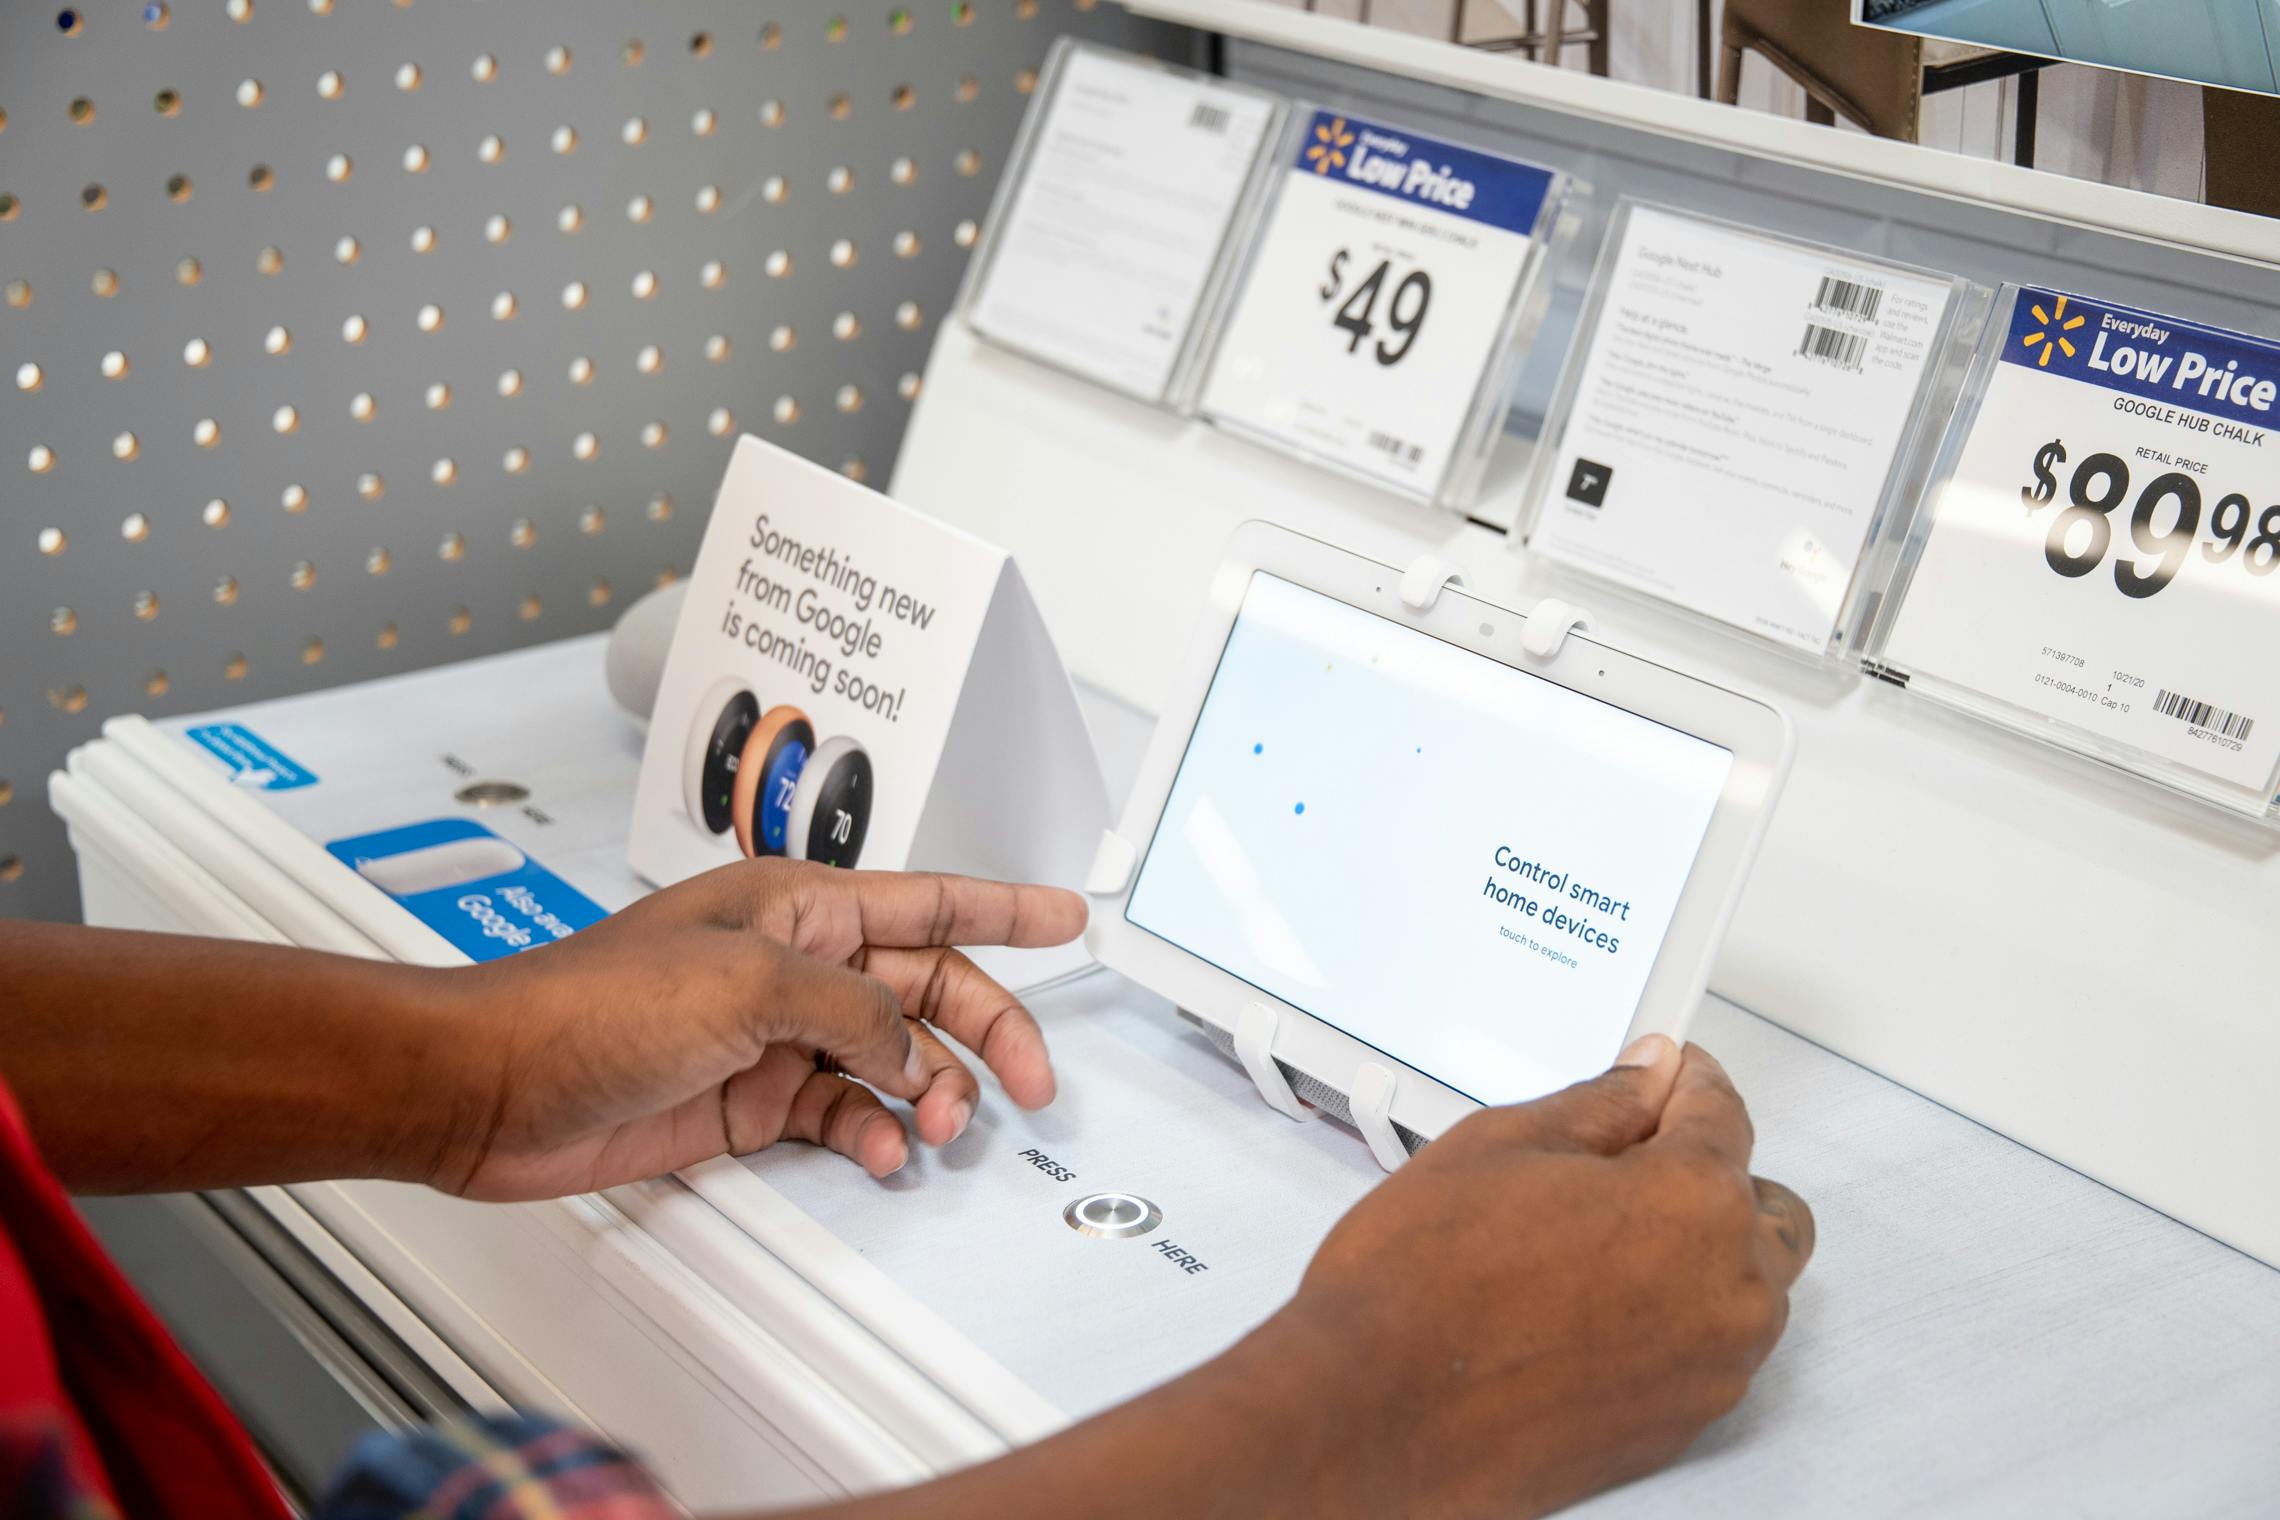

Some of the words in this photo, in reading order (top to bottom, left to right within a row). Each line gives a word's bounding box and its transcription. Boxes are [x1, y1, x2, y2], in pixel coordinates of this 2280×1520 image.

[1346, 143, 1407, 190] Low
[1403, 159, 1476, 210] Price
[2101, 313, 2170, 345] Everyday
[2087, 331, 2174, 384] Low
[2172, 351, 2277, 412] Price
[2113, 397, 2175, 424] GOOGLE
[2177, 414, 2210, 433] HUB
[2212, 422, 2266, 447] CHALK
[2135, 446, 2172, 466] RETAIL
[2175, 457, 2209, 475] PRICE
[750, 514, 877, 612] Something
[878, 586, 936, 631] new
[736, 558, 793, 614] from
[796, 589, 882, 659] Google
[722, 600, 743, 639] is
[745, 623, 832, 695] coming
[834, 669, 906, 723] soon!
[2041, 646, 2085, 669] 571397708
[2034, 673, 2099, 703] 0121-0004-0010
[2100, 696, 2119, 711] Cap
[2120, 702, 2131, 713] 10
[2106, 683, 2113, 692] 1
[2112, 670, 2145, 689] 10/21/20
[2187, 726, 2244, 752] 84277610729
[775, 777, 796, 812] 72
[830, 808, 852, 845] 70
[1494, 845, 1569, 893] Control
[1569, 883, 1631, 921] smart
[457, 894, 531, 947] Google
[1483, 876, 1538, 917] home
[1542, 905, 1620, 954] devices
[1499, 925, 1528, 946] touch
[1529, 939, 1540, 951] to
[1540, 946, 1578, 969] explore
[1017, 1148, 1077, 1183] PRESS
[1151, 1239, 1209, 1275] HERE
